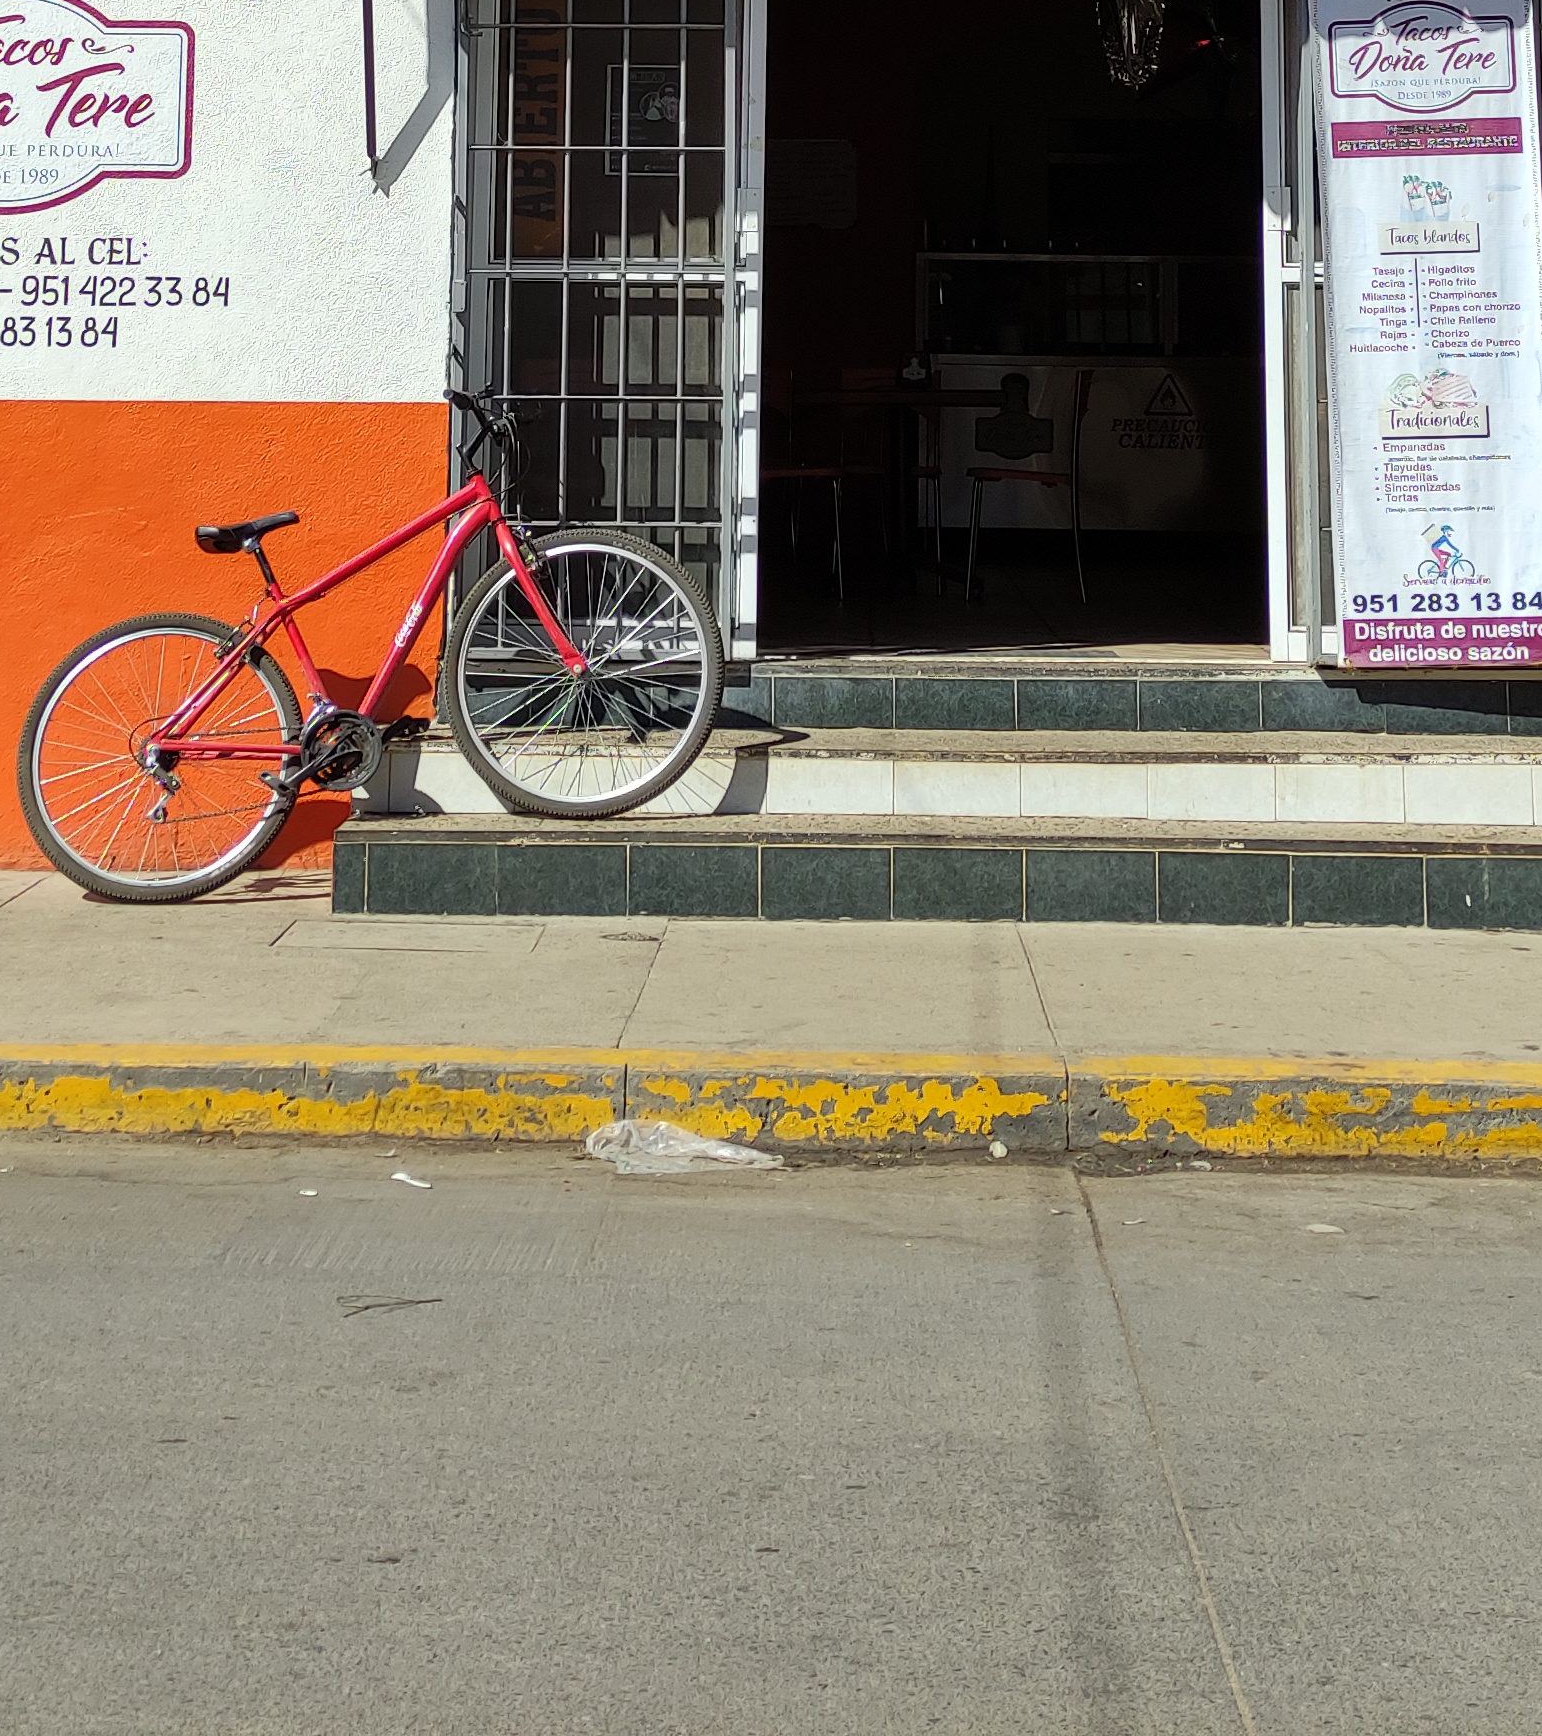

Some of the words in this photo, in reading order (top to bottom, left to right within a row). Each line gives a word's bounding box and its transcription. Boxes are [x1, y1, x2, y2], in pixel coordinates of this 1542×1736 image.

[1390, 16, 1454, 45] Tacos
[1349, 41, 1429, 81] Doña
[1435, 38, 1497, 75] Tere
[36, 62, 156, 138] Tere
[514, 9, 558, 222] ABERTO
[20, 168, 60, 185] 1989
[1386, 228, 1419, 245] Tacos
[1424, 229, 1471, 244] blandos
[34, 237, 75, 264] AL
[87, 237, 149, 264] CEL:
[21, 275, 69, 306] 951
[78, 275, 137, 307] 422
[143, 277, 184, 306] 33
[193, 277, 230, 306] 84
[45, 317, 73, 347] 13
[80, 316, 119, 348] 84
[1431, 330, 1470, 338] Chorizo
[1386, 409, 1479, 430] Tradicionales
[1383, 443, 1446, 453] Empanadas
[1385, 494, 1419, 502] Tortas
[1353, 594, 1398, 613] 951
[1411, 593, 1460, 612] 283
[1471, 592, 1502, 611] 13
[1354, 622, 1435, 640] Disfruta
[1440, 622, 1466, 639] de
[1369, 644, 1462, 662] delicioso
[1468, 642, 1530, 660] sazón
